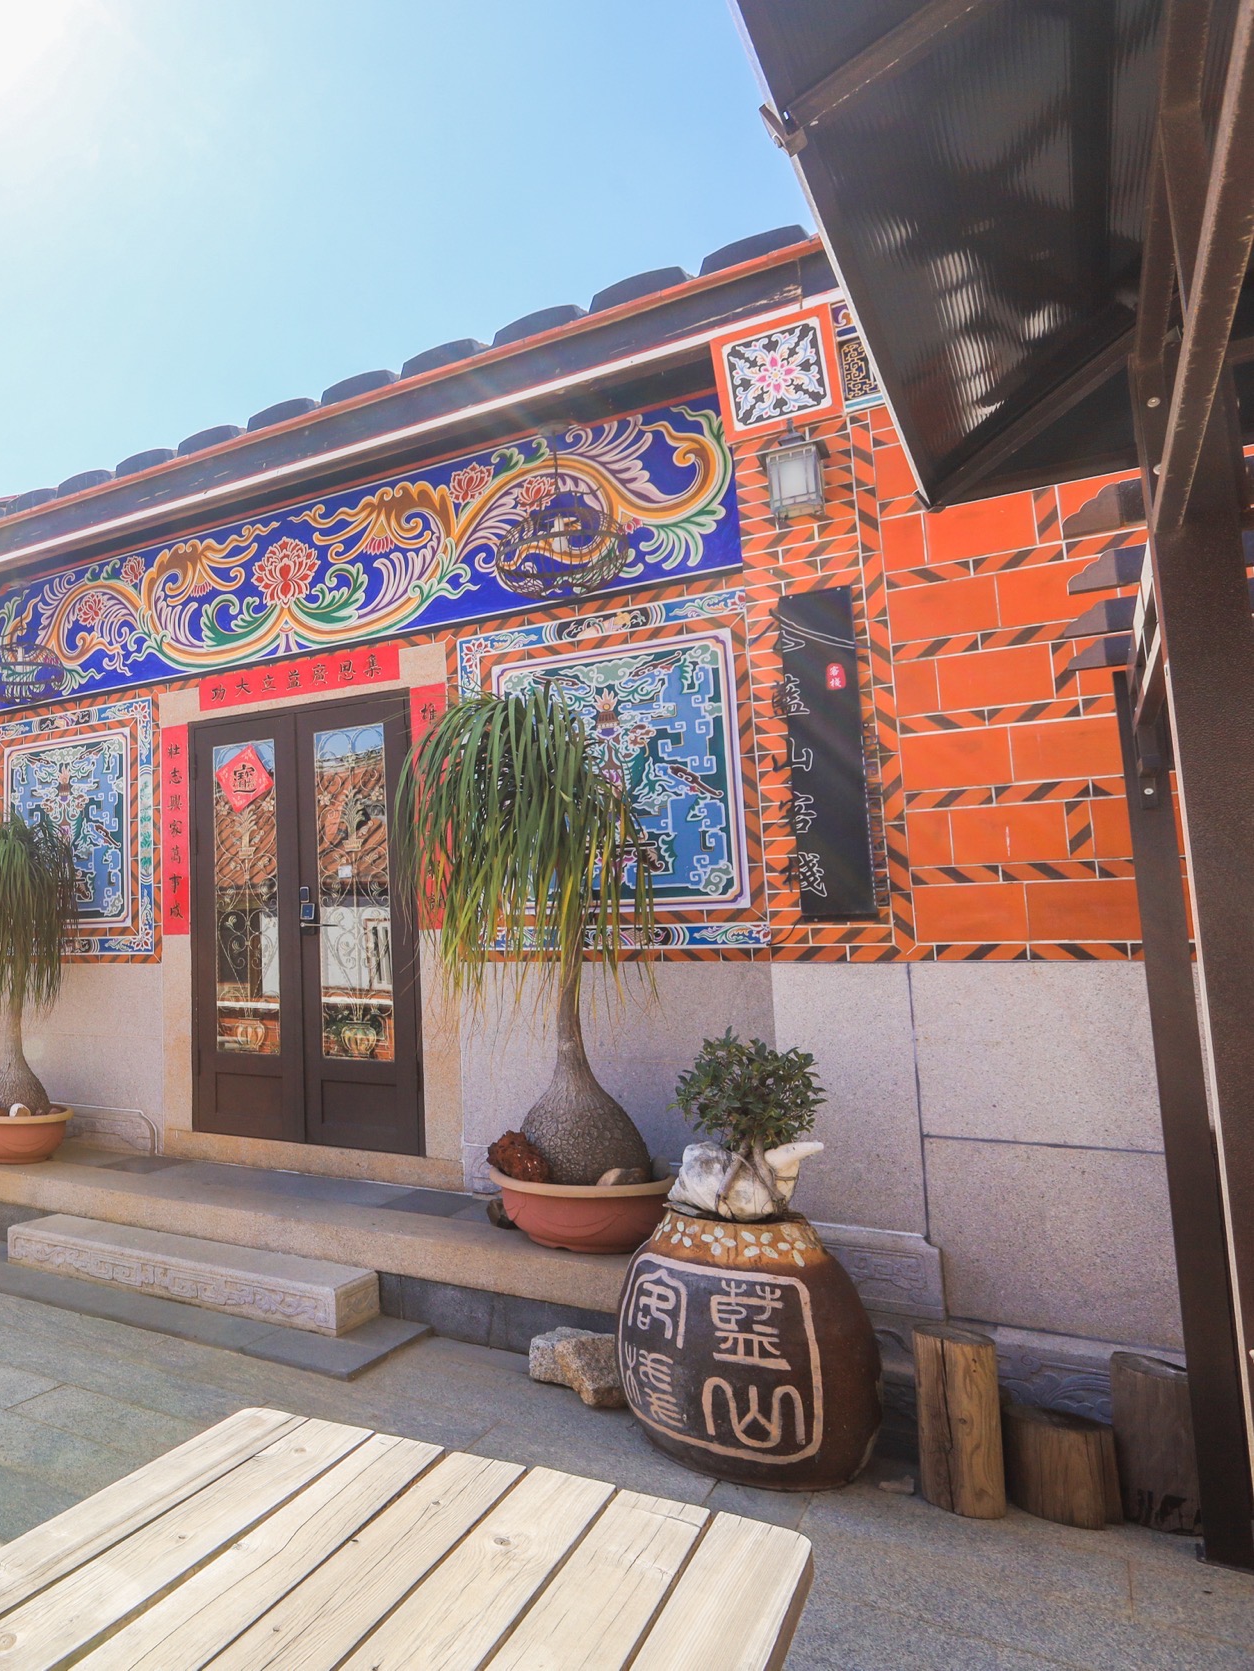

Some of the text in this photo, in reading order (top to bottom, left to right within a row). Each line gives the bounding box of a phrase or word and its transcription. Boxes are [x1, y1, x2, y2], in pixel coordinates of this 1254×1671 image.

[829, 665, 842, 688] 客棧
[167, 743, 184, 920] 壯志興家萬事成
[769, 673, 828, 898] 藍山客棧
